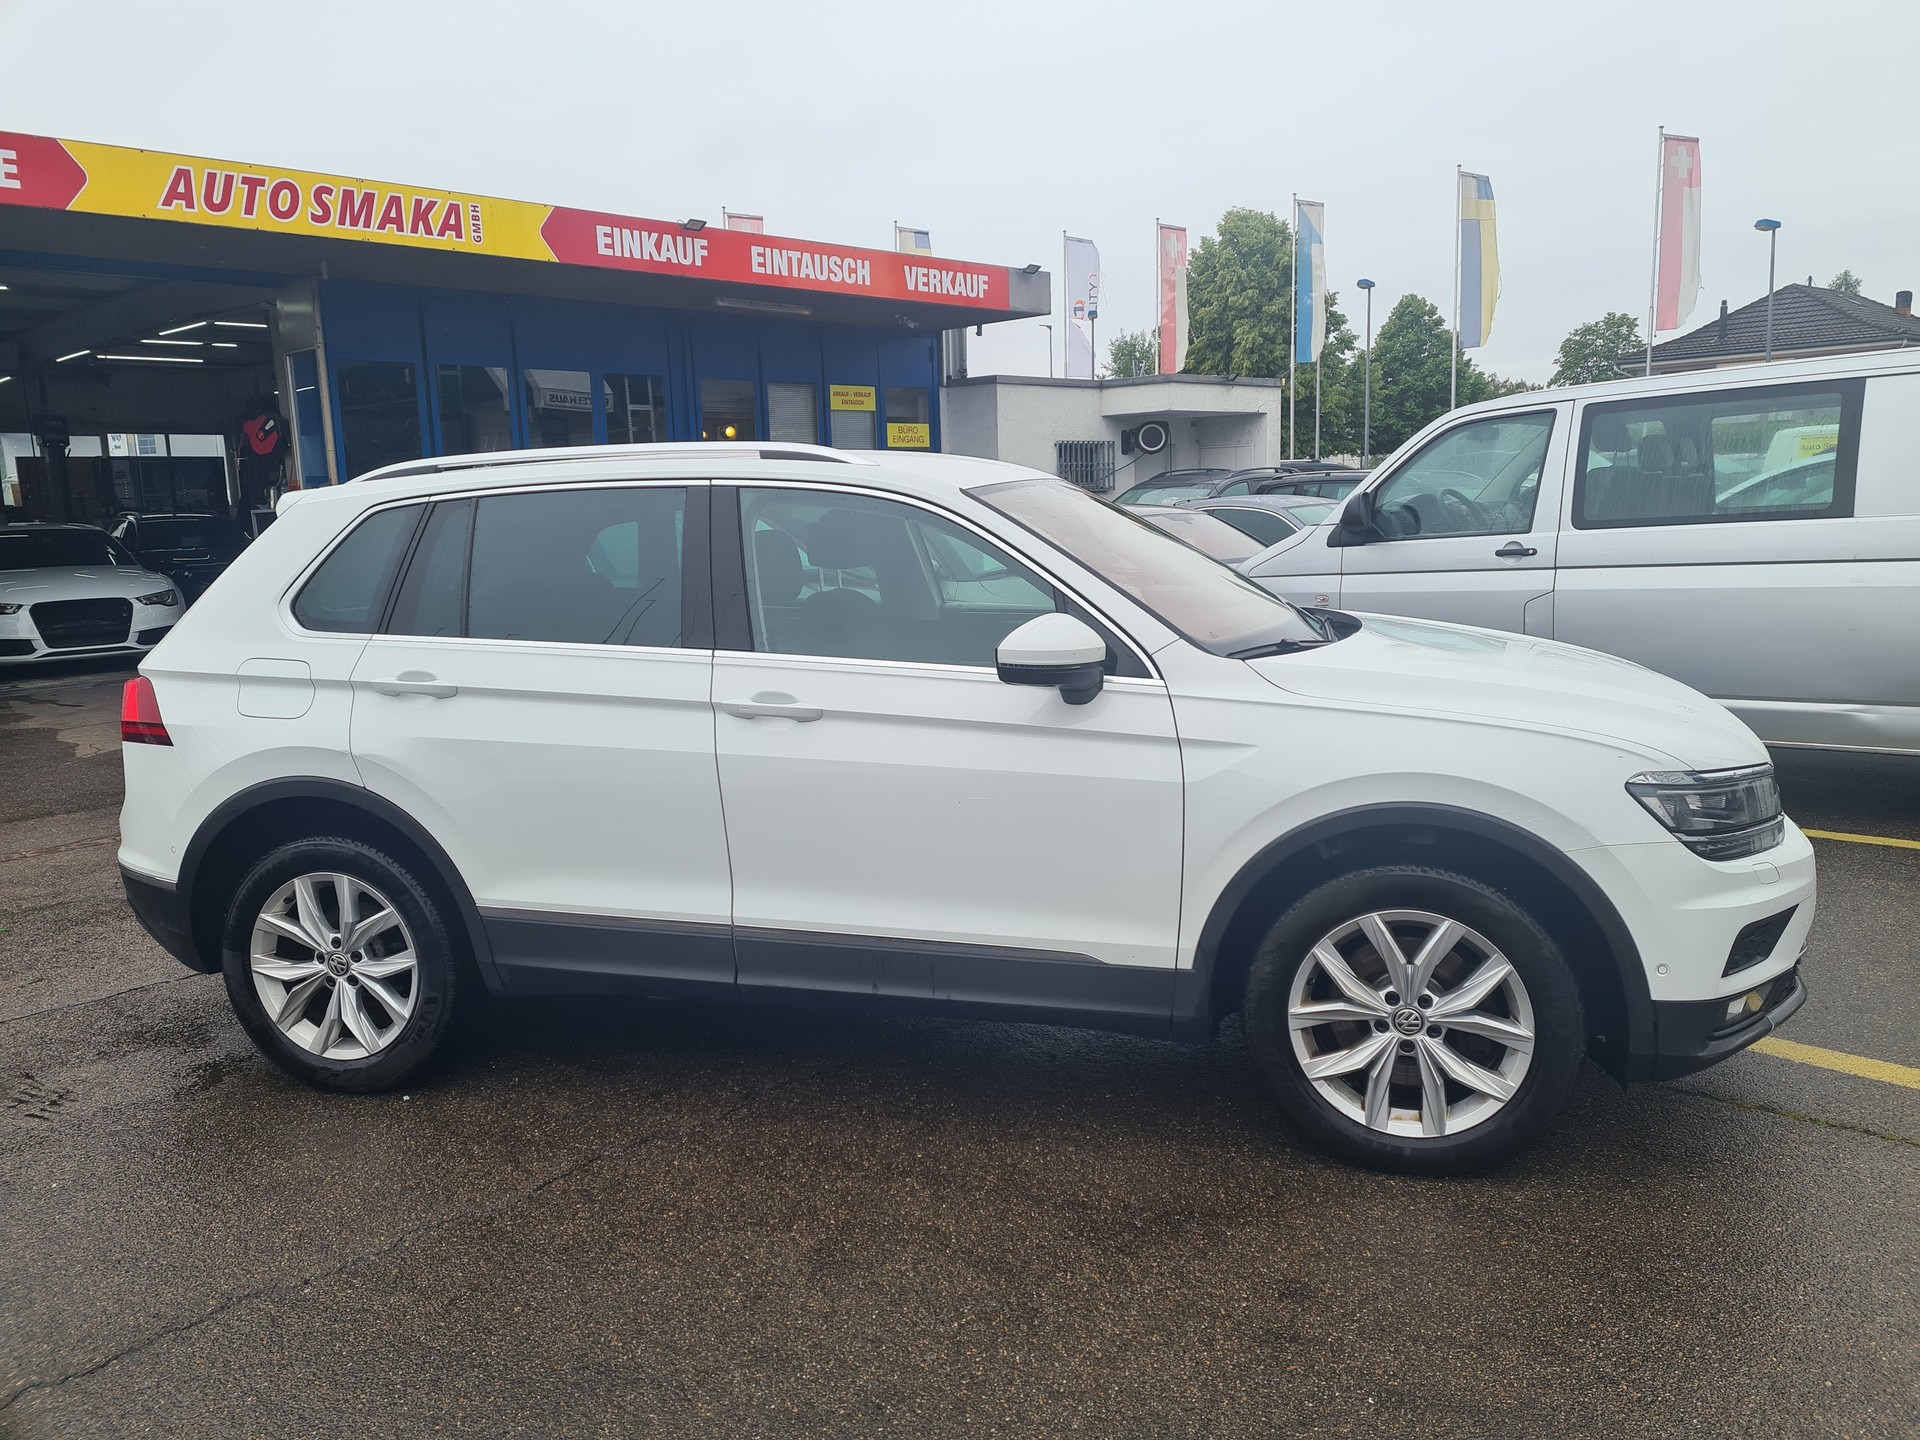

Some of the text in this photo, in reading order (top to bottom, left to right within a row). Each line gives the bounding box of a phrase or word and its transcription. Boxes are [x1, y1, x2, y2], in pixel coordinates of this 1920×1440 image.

[158, 165, 482, 243] AUTO SMAKA GMBH
[596, 225, 989, 298] EINKAUF EINTAUSCH VERKAUF
[892, 435, 924, 444] EINGANG
[898, 425, 918, 434] BÜRO
